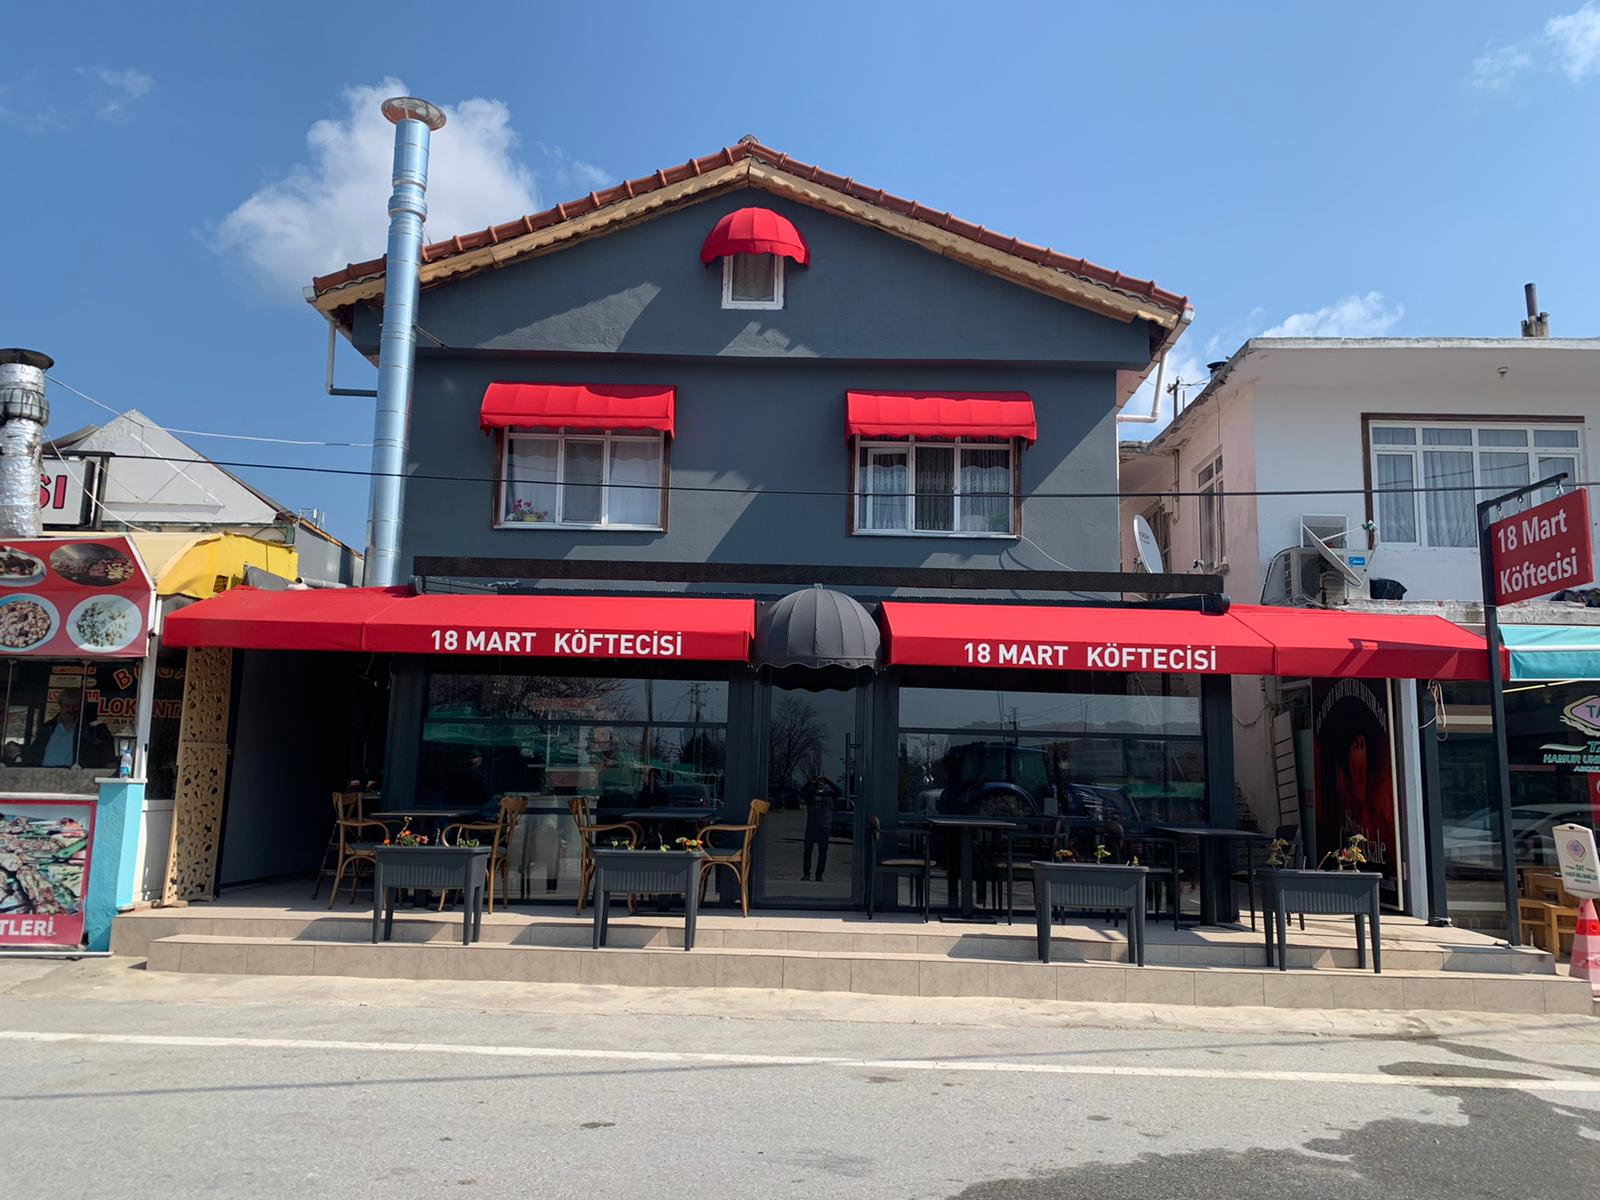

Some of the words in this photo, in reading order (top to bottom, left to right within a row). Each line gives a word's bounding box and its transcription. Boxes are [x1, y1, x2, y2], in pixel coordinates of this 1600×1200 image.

[1498, 525, 1517, 553] 18
[1522, 508, 1567, 546] Mart
[1500, 547, 1578, 595] Köftecisi
[431, 630, 458, 651] 18
[466, 631, 536, 652] MART
[554, 629, 683, 656] KÖFTECİSİ
[964, 642, 991, 664] 18
[998, 643, 1069, 666] MART
[1087, 643, 1217, 671] KÖFTECİSİ
